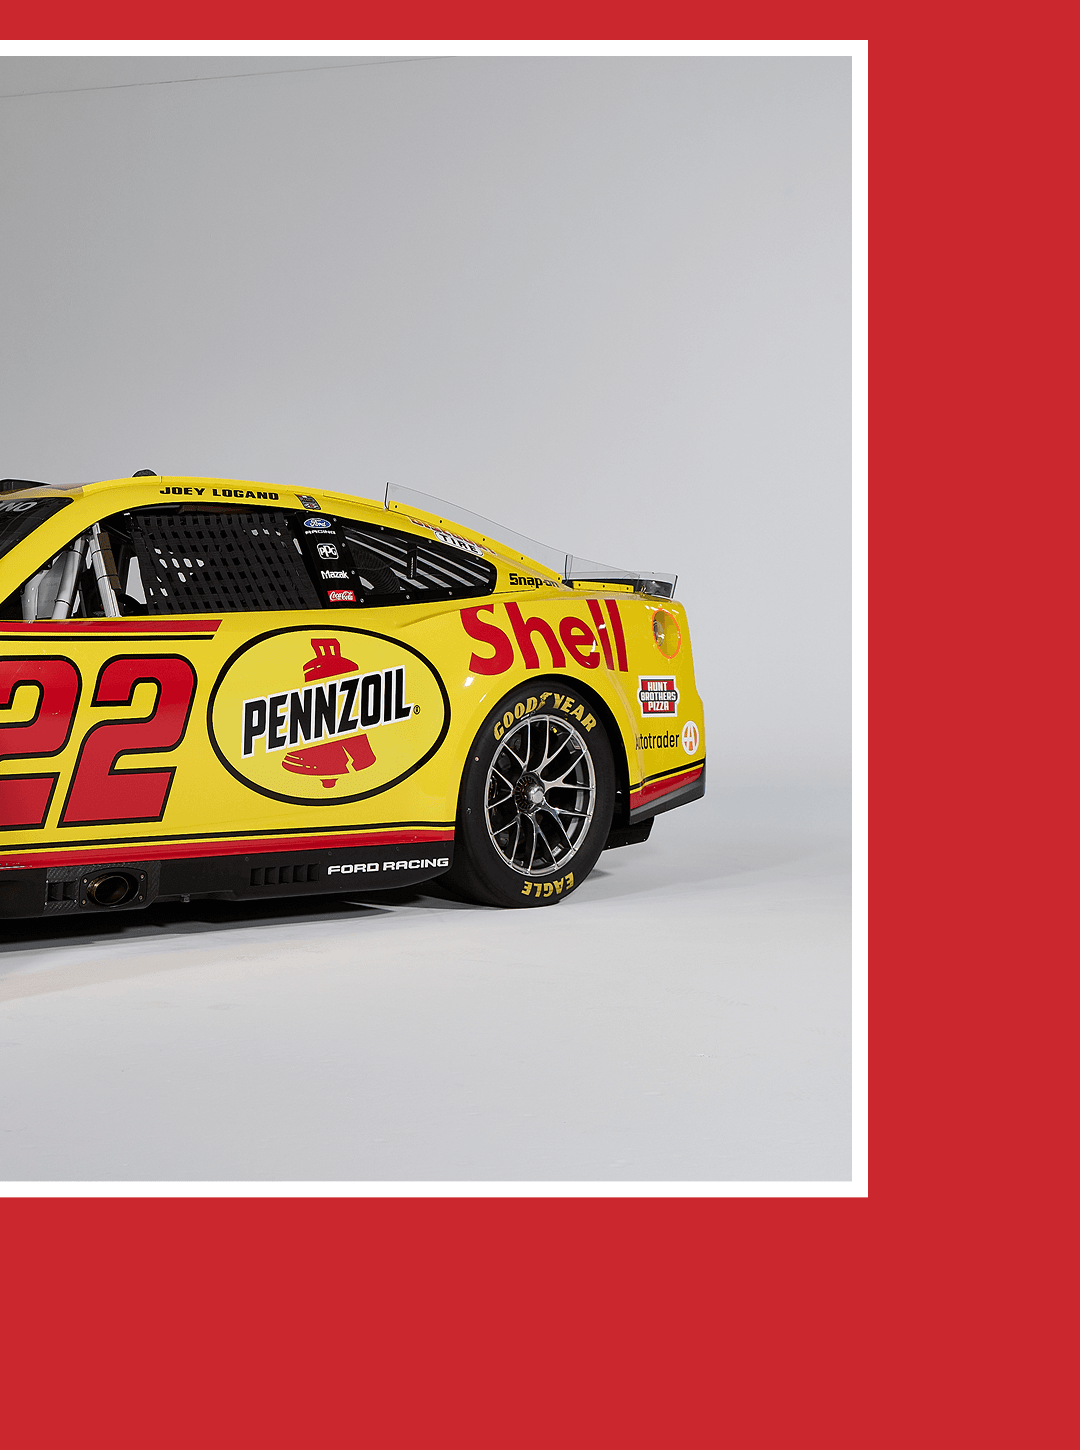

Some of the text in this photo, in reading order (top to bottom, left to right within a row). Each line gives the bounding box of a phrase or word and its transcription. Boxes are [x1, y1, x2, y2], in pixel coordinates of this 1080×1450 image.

[159, 486, 279, 500] JOEY LOGANO
[318, 545, 337, 557] PPG
[321, 570, 349, 579] Mazak
[509, 573, 559, 588] Snap-on
[329, 591, 353, 601] Coca-Cola
[460, 599, 628, 676] Shell
[647, 681, 668, 691] HUNT
[640, 691, 676, 701] BROTHERS
[243, 667, 412, 758] PENNZOIL
[648, 701, 669, 711] PIZZA
[328, 857, 449, 876] FORD RACING
[522, 871, 575, 898] EAGLE
